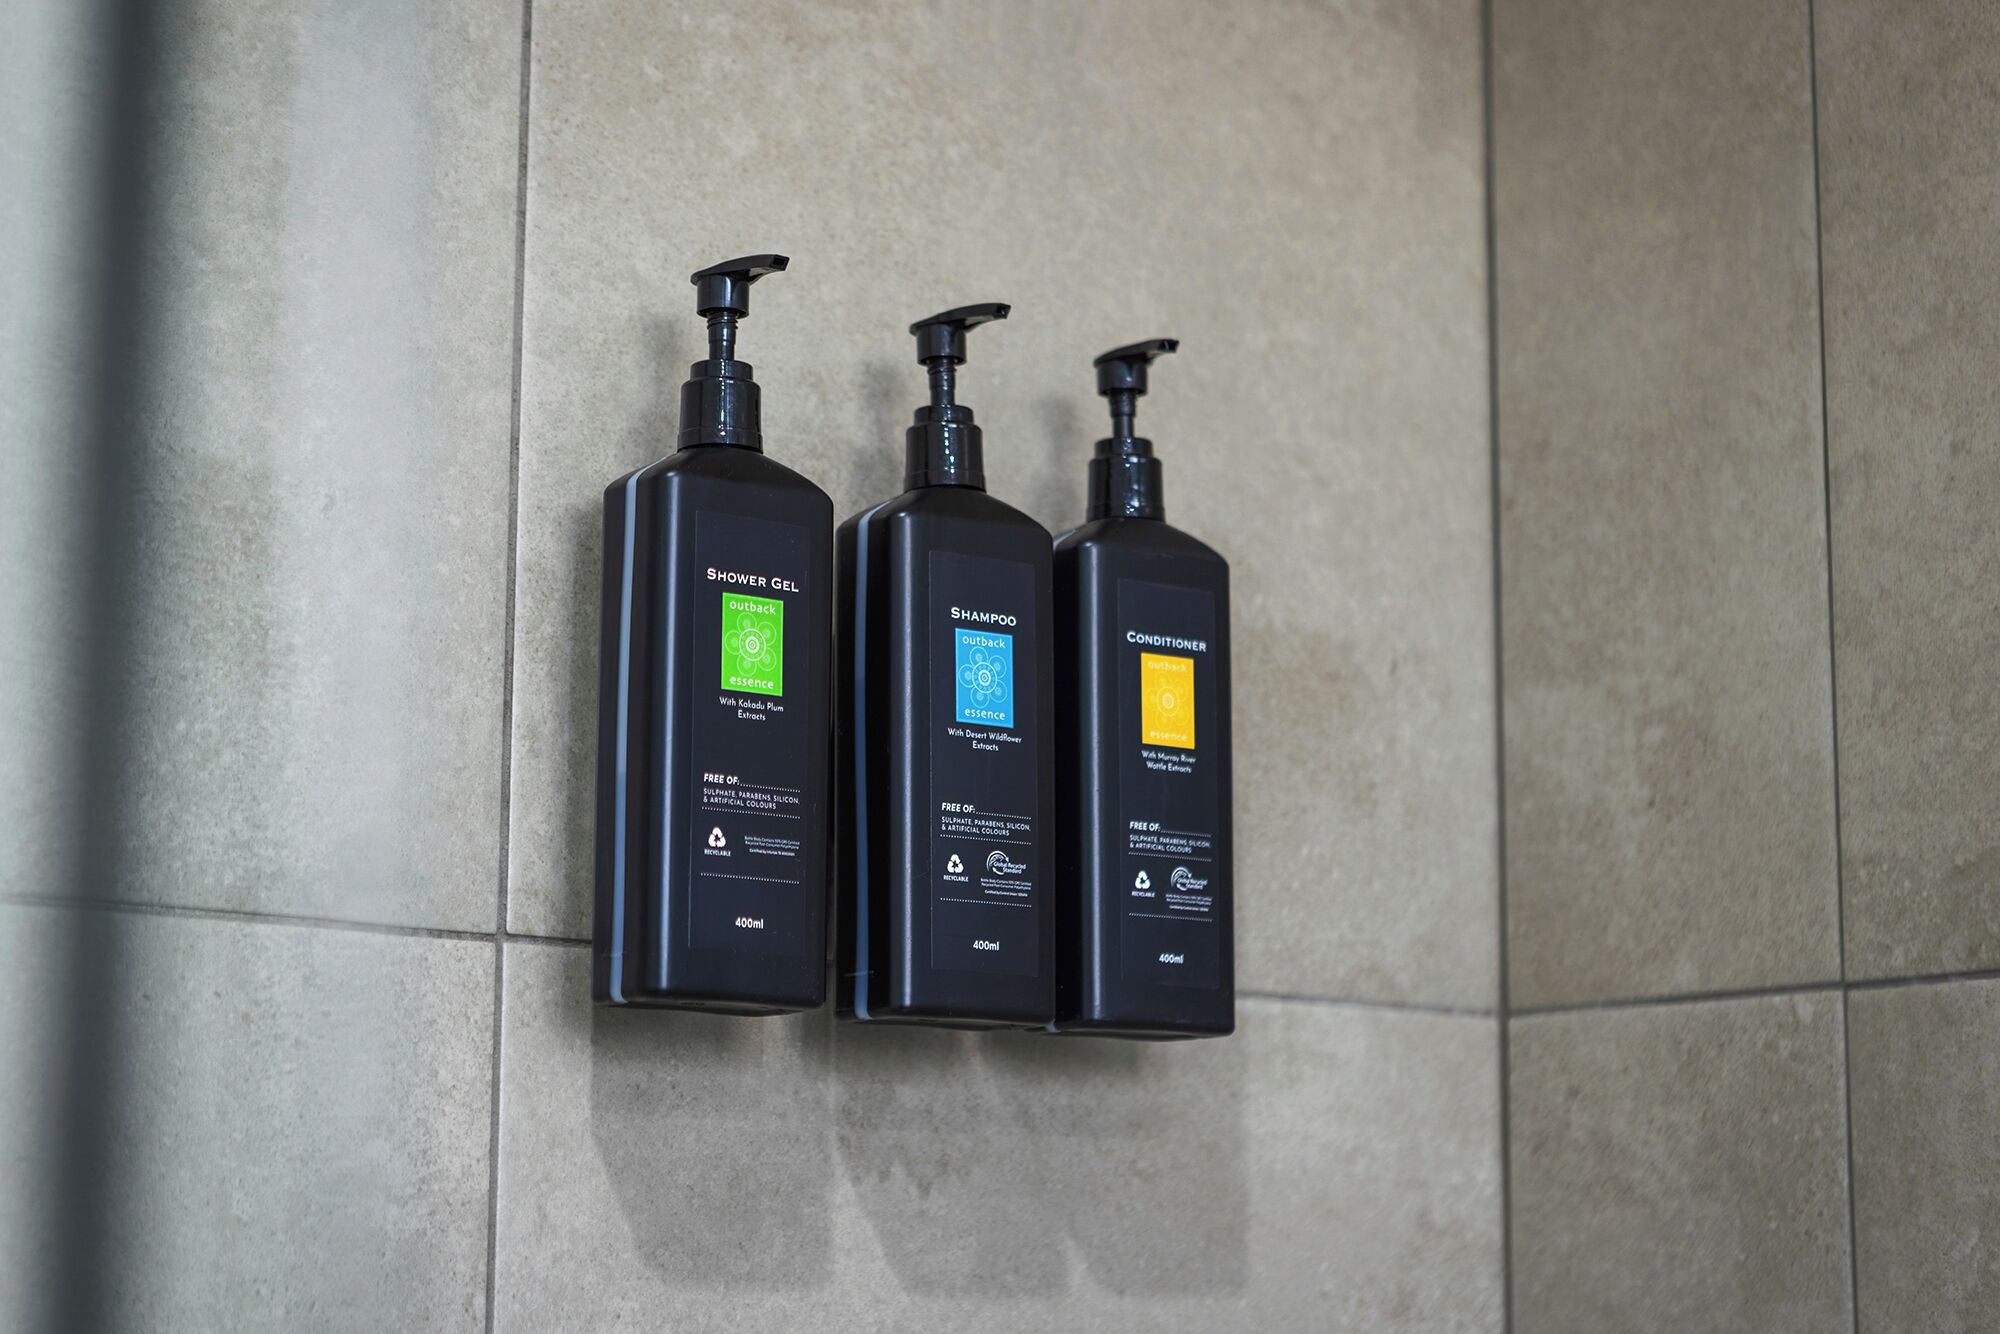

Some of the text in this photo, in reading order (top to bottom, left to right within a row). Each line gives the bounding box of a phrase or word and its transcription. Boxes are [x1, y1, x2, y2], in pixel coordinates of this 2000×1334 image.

[706, 567, 800, 593] SHOWER GEL
[729, 601, 776, 616] outback
[950, 606, 1017, 627] SHAMPOO
[962, 635, 1006, 649] outback
[1126, 631, 1207, 653] CONDITIONER
[1147, 661, 1187, 673] outback
[729, 676, 774, 690] essence
[719, 696, 784, 712] With Kakadu Plum
[737, 709, 766, 721] Extracts
[964, 707, 1006, 720] essence
[947, 727, 1022, 744] With Desert Wildflower
[1149, 730, 1187, 742] essence
[972, 740, 999, 752] Extracts
[1141, 749, 1197, 763] With Murray River
[1146, 760, 1192, 774] Wattle Extracts
[703, 773, 725, 784] FREE
[702, 795, 777, 810] & ARTIFICIAL COLOURS
[773, 794, 801, 805] SILICON,
[941, 802, 961, 813] FREE
[941, 823, 1010, 837] & ARTIFICIAL COLOURS
[1006, 822, 1031, 832] SILICON,
[1129, 821, 1148, 831] FREE
[704, 848, 732, 857] RECYCLABLE
[1135, 843, 1165, 852] ARTIFICIAL
[1166, 845, 1192, 854] COLOURS
[943, 874, 969, 883] RECYCLABLE
[735, 916, 764, 929] 400ml
[973, 940, 1000, 951] 400ml
[1159, 953, 1185, 964] 400ml
